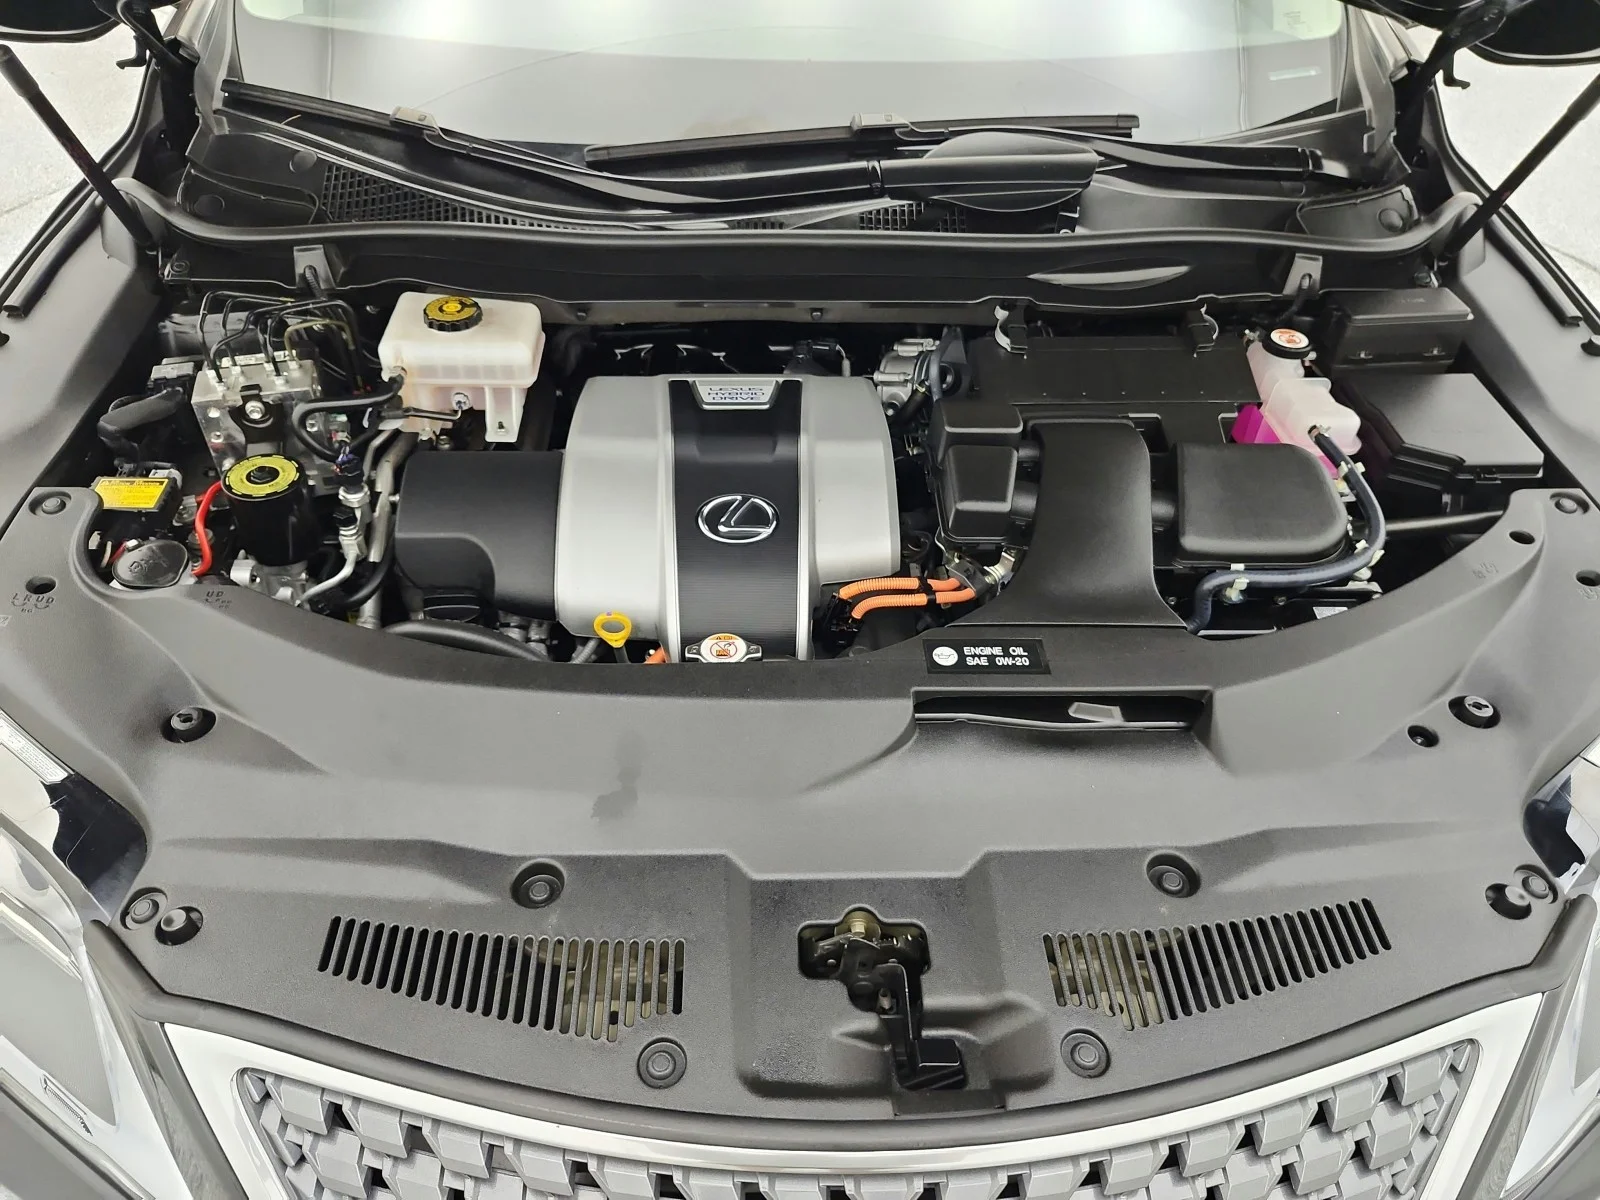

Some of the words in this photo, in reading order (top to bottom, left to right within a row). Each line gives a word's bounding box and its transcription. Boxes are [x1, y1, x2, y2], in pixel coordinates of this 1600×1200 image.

[963, 646, 1004, 656] ENGINE
[1009, 646, 1028, 656] OIL
[966, 656, 989, 666] SAE
[995, 656, 1030, 666] 0W-20
